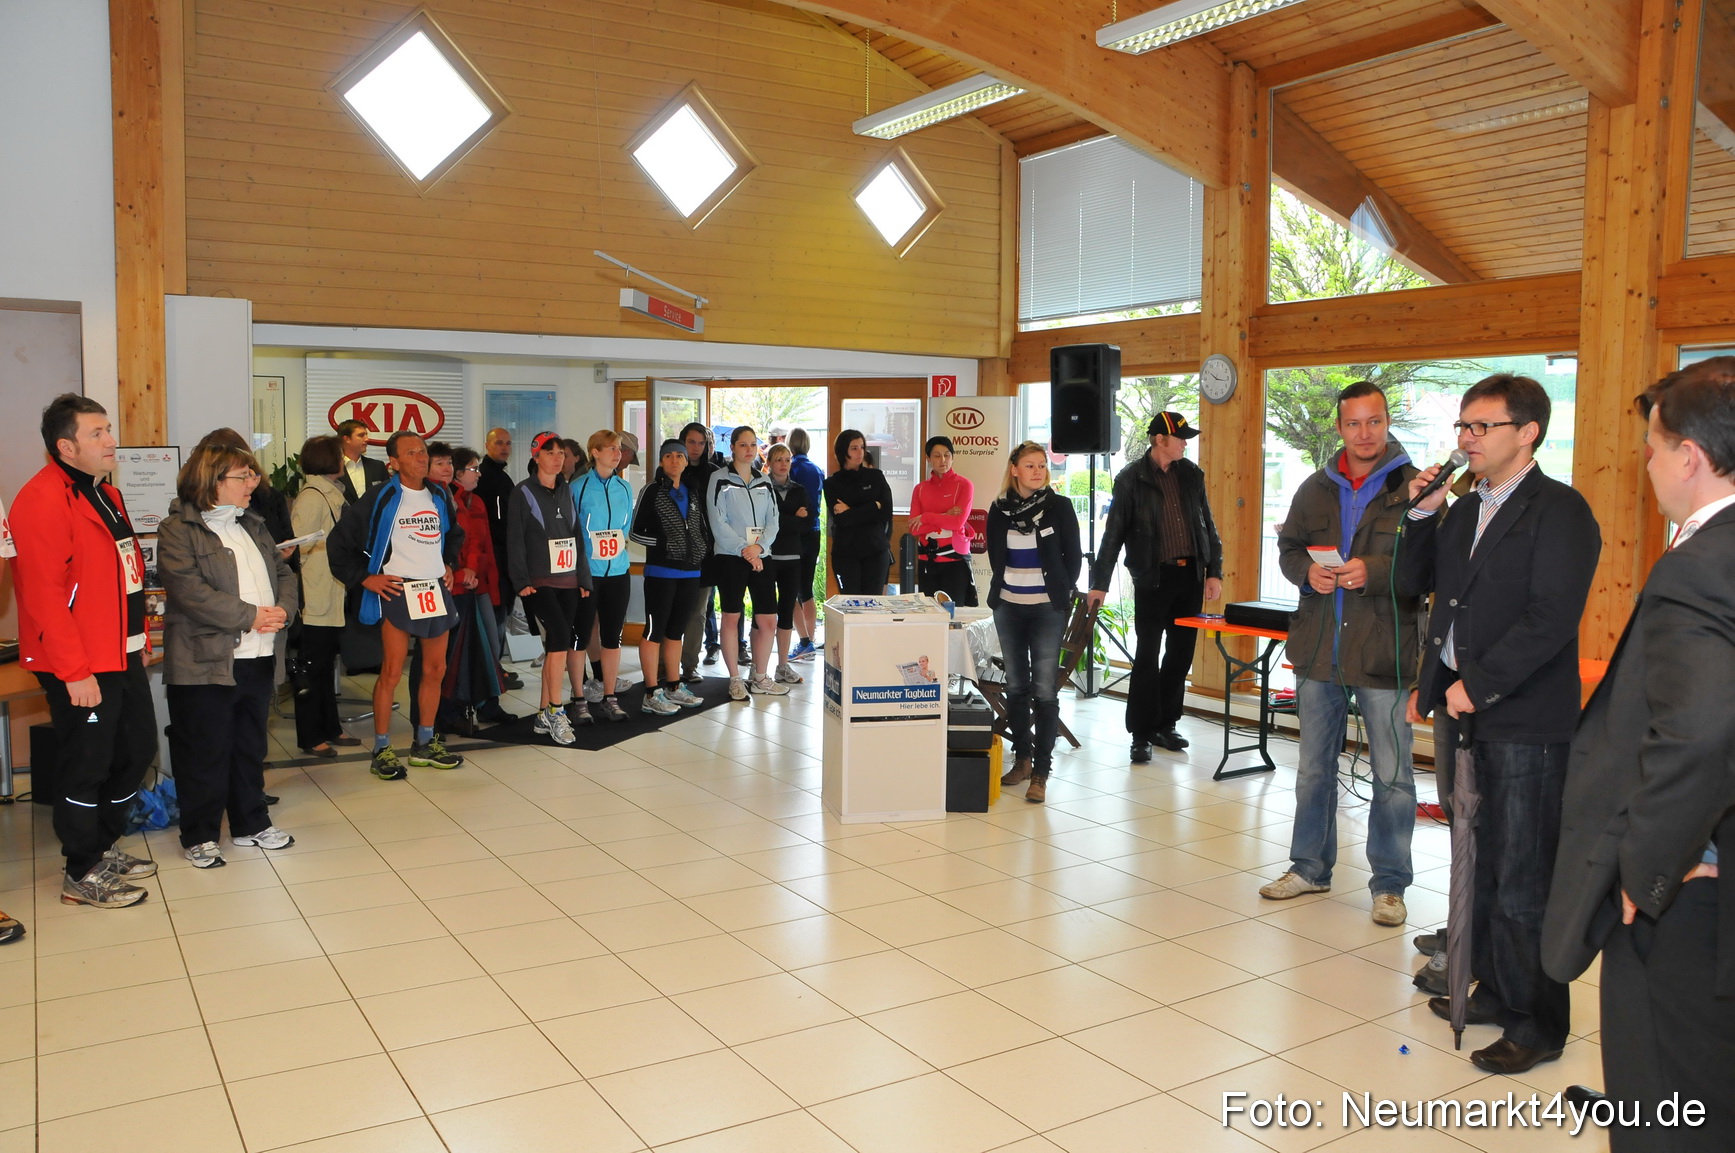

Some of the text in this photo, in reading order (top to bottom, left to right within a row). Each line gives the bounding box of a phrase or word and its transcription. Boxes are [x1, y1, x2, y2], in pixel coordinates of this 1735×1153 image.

[663, 305, 682, 322] Service
[351, 402, 426, 433] KIA
[952, 413, 978, 424] KIA
[952, 435, 999, 447] MOTORS
[398, 517, 438, 526] GERHART
[974, 532, 984, 540] IA
[599, 538, 618, 557] 69
[557, 549, 573, 568] 40
[126, 554, 140, 584] 3
[417, 591, 437, 614] 18
[856, 688, 936, 700] Neumarkter Tagblatt
